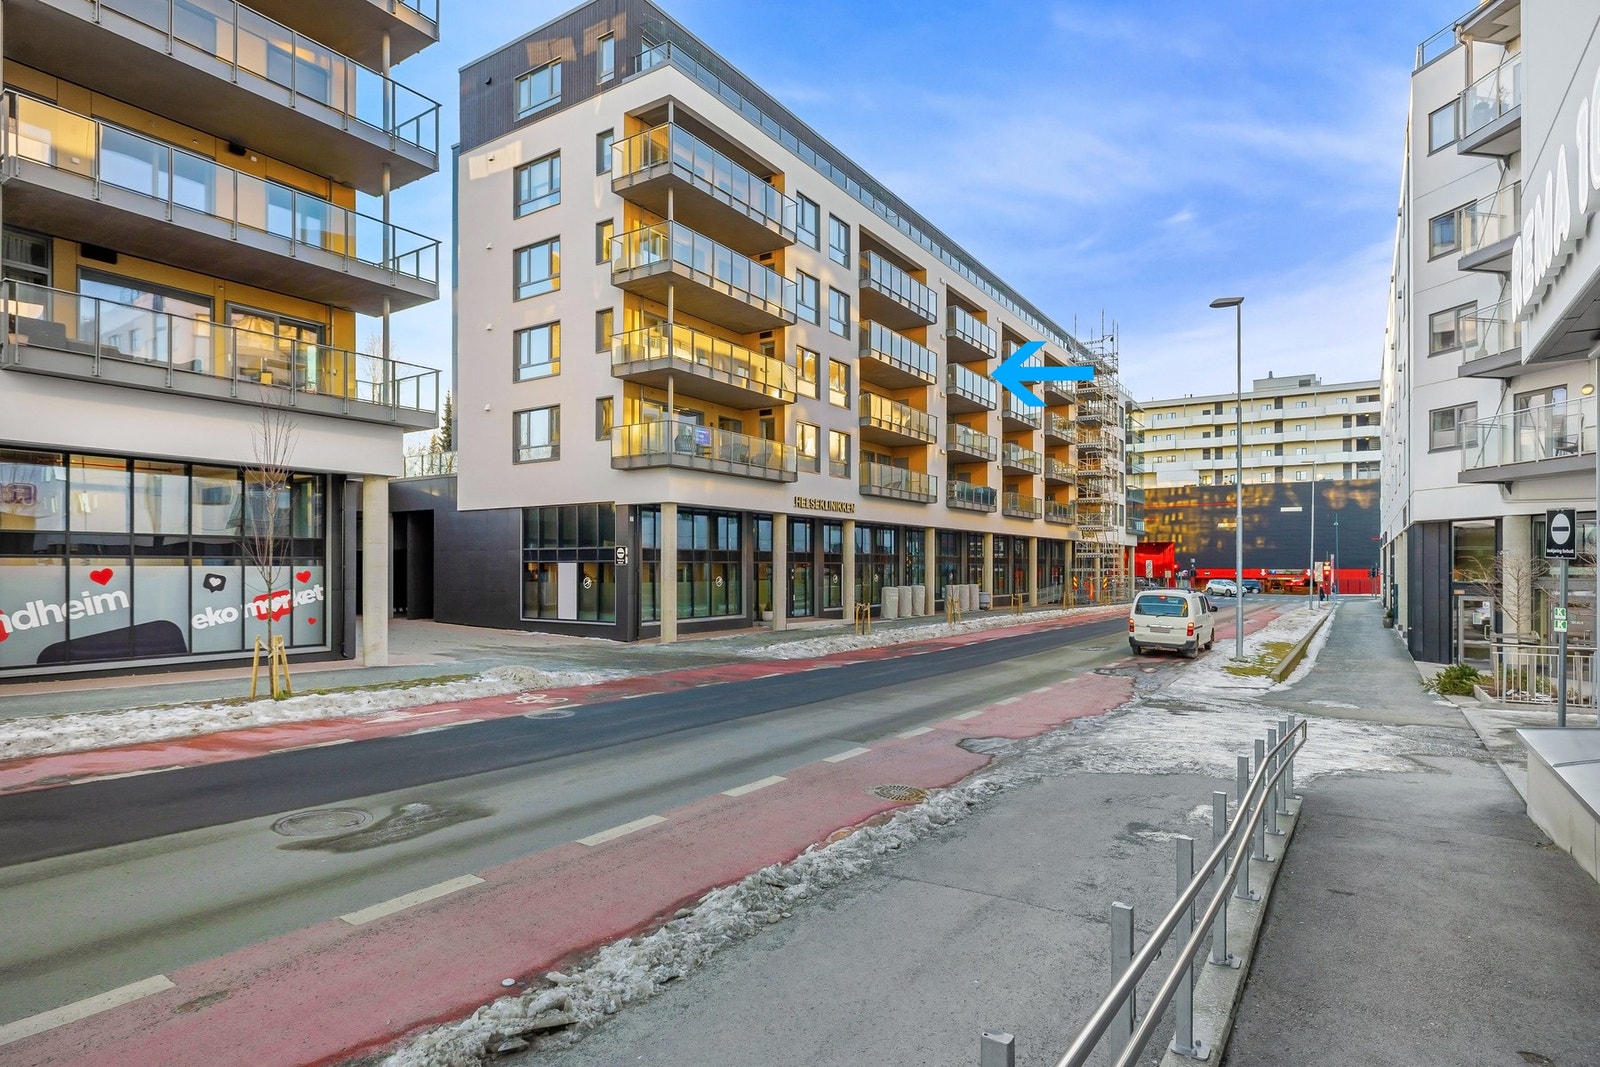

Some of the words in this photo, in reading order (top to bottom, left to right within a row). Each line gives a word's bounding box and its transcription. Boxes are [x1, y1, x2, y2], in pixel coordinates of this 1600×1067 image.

[1512, 143, 1571, 323] REMA
[793, 496, 856, 513] HELSEKLINIKKEN
[191, 606, 239, 629] eko
